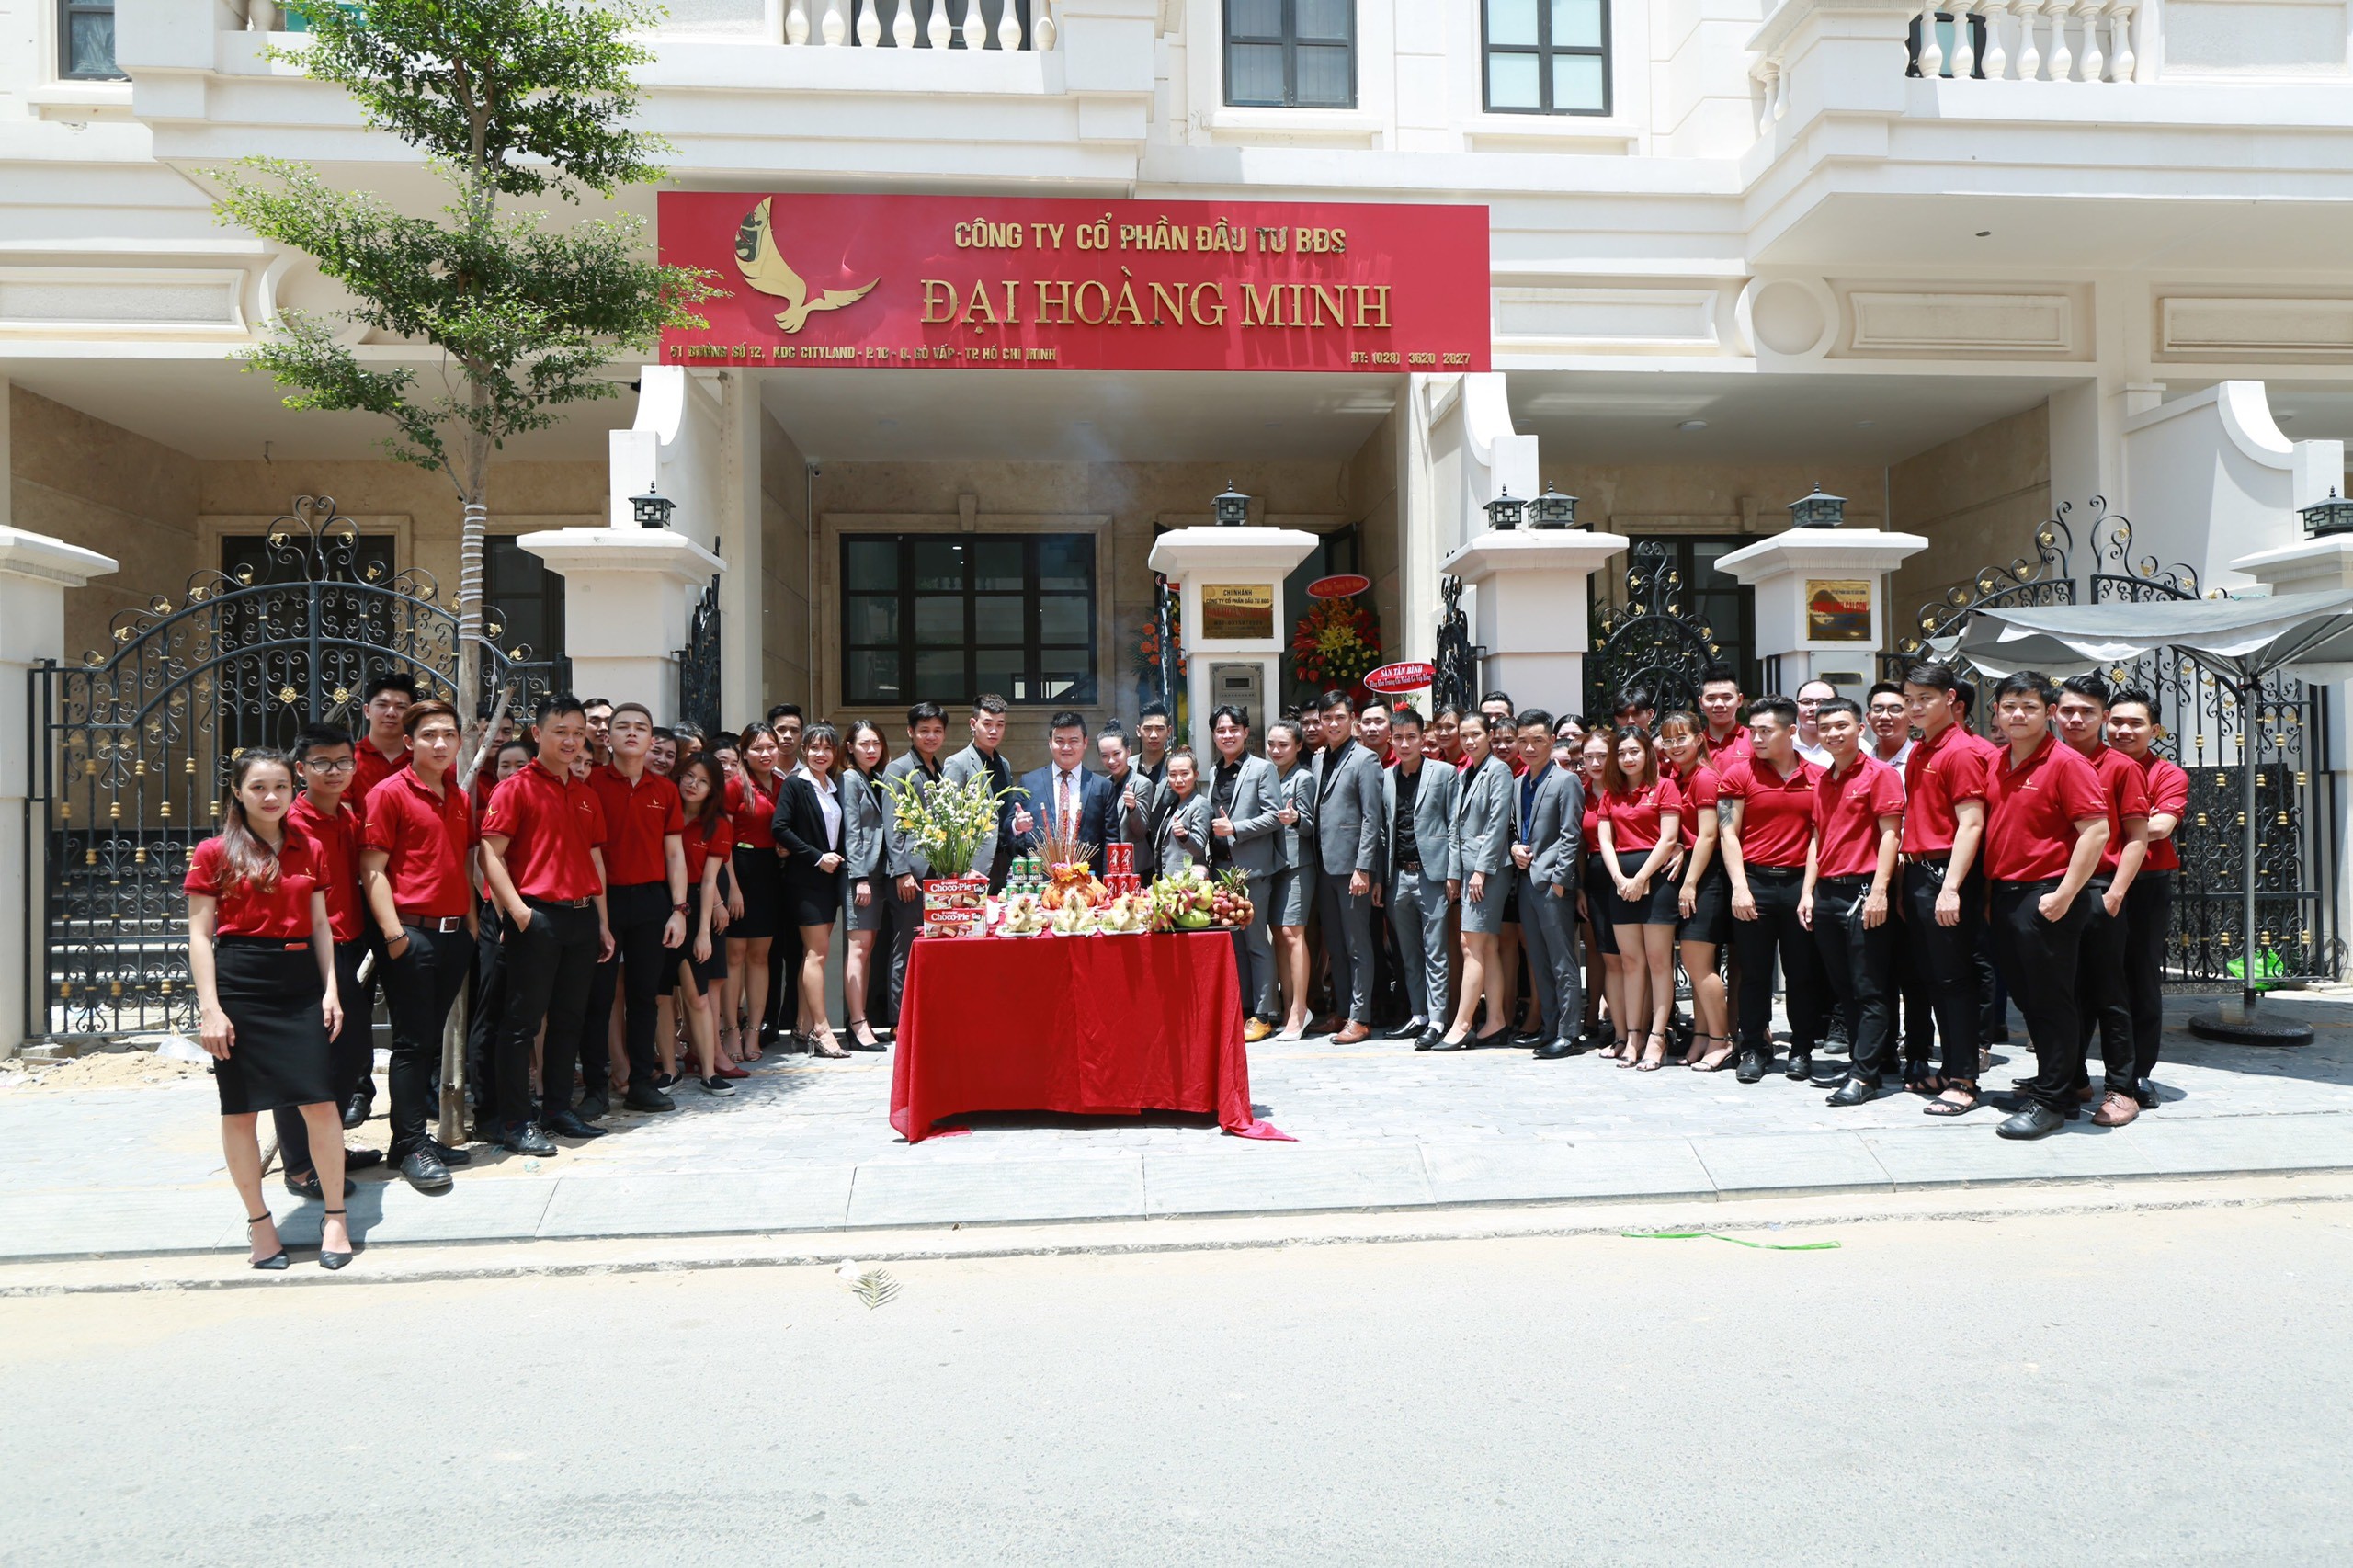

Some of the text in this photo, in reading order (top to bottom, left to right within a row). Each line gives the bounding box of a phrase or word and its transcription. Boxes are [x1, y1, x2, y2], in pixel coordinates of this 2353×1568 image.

[955, 217, 1023, 248] CÔNG
[1030, 223, 1065, 249] TY
[1076, 212, 1113, 250] CỔ
[1120, 215, 1188, 251] PHẦN
[1196, 217, 1247, 252] ĐẦU
[1295, 227, 1347, 254] BĐS
[920, 265, 1392, 334] ĐẠI HOÀNG MINH
[732, 342, 746, 358] SỐ
[773, 346, 796, 358] KDC
[801, 346, 856, 358] CITYLAND
[933, 343, 955, 359] VẤP
[983, 345, 997, 360] HỒ
[1002, 345, 1021, 360] CHÍ
[1026, 347, 1057, 360] MINH
[1372, 351, 1400, 365] (028)
[1408, 352, 1436, 364] 3620
[1443, 352, 1471, 364] 2827
